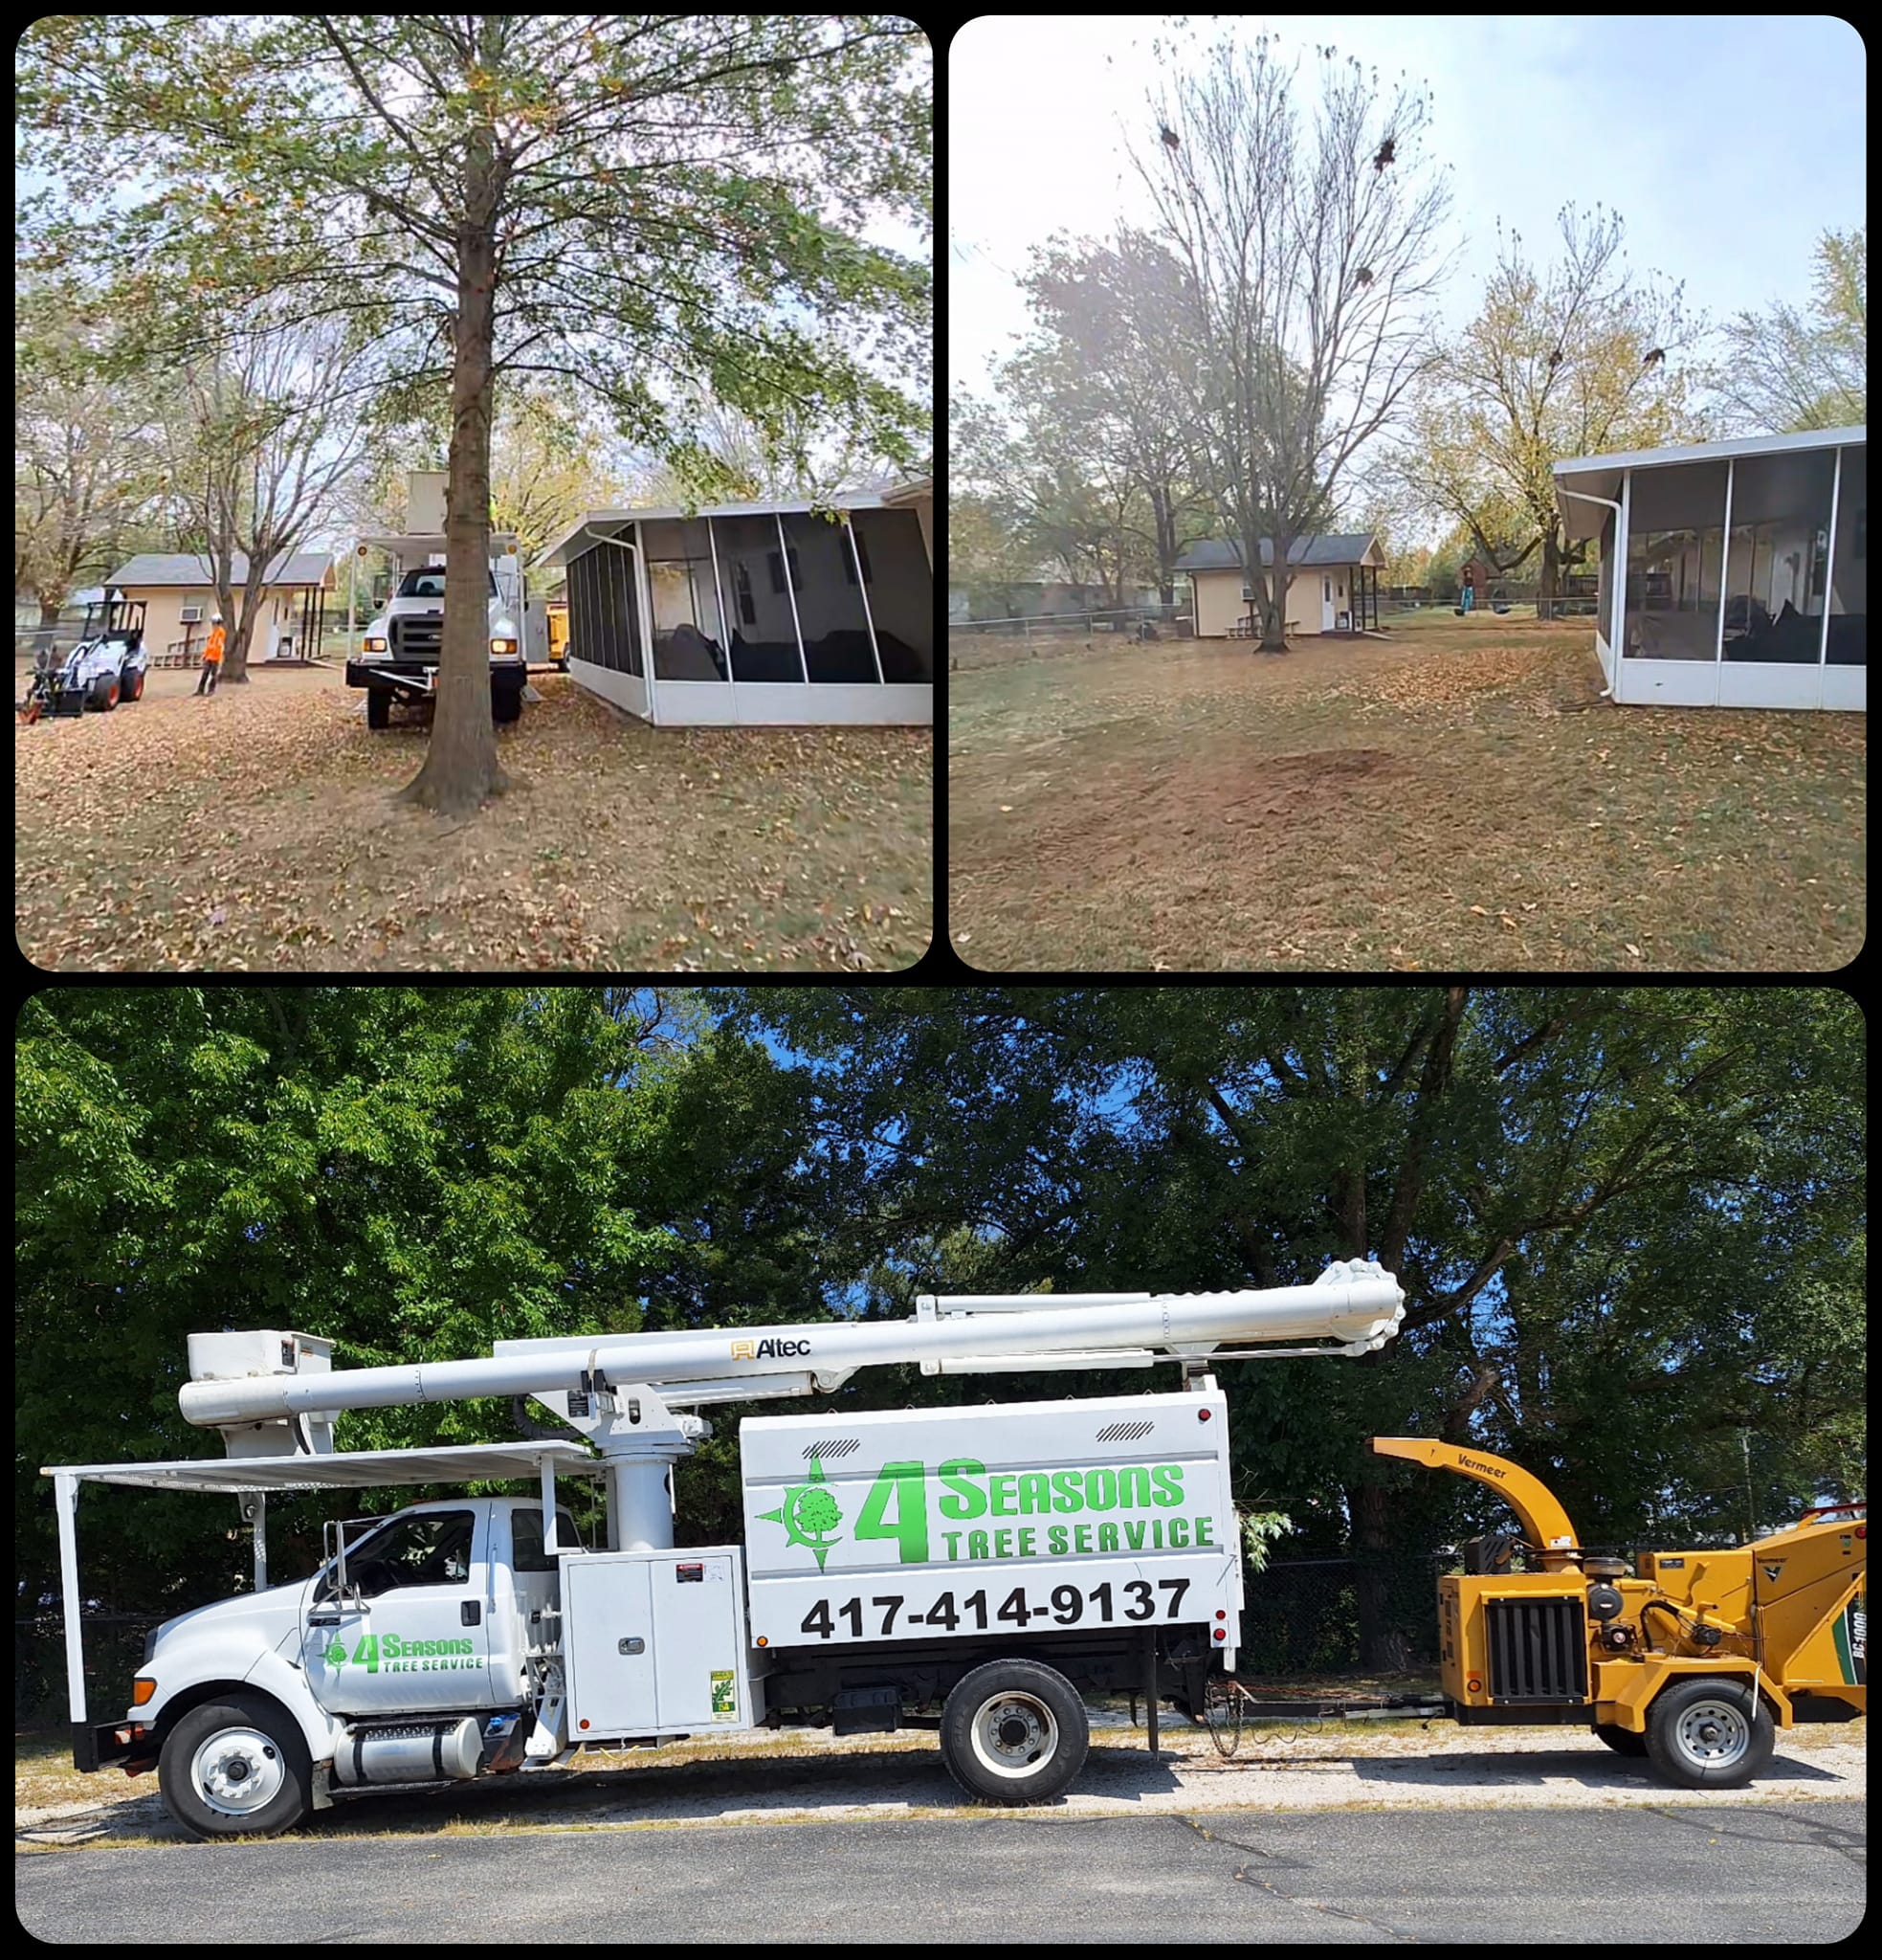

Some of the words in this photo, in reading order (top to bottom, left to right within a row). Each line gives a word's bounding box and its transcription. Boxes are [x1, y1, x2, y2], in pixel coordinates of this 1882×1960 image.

[756, 1338, 811, 1359] Altec
[1457, 1453, 1507, 1480] Vermeer
[853, 1460, 929, 1564] 4
[938, 1458, 1185, 1520] SEASONS
[941, 1527, 1037, 1562] TREE
[1048, 1516, 1214, 1555] SERVICE
[801, 1577, 1191, 1639] 417-414-9137
[351, 1634, 379, 1674] 4
[382, 1633, 474, 1659] SEASONS
[385, 1660, 418, 1673] TREE
[422, 1658, 483, 1672] SERVICE
